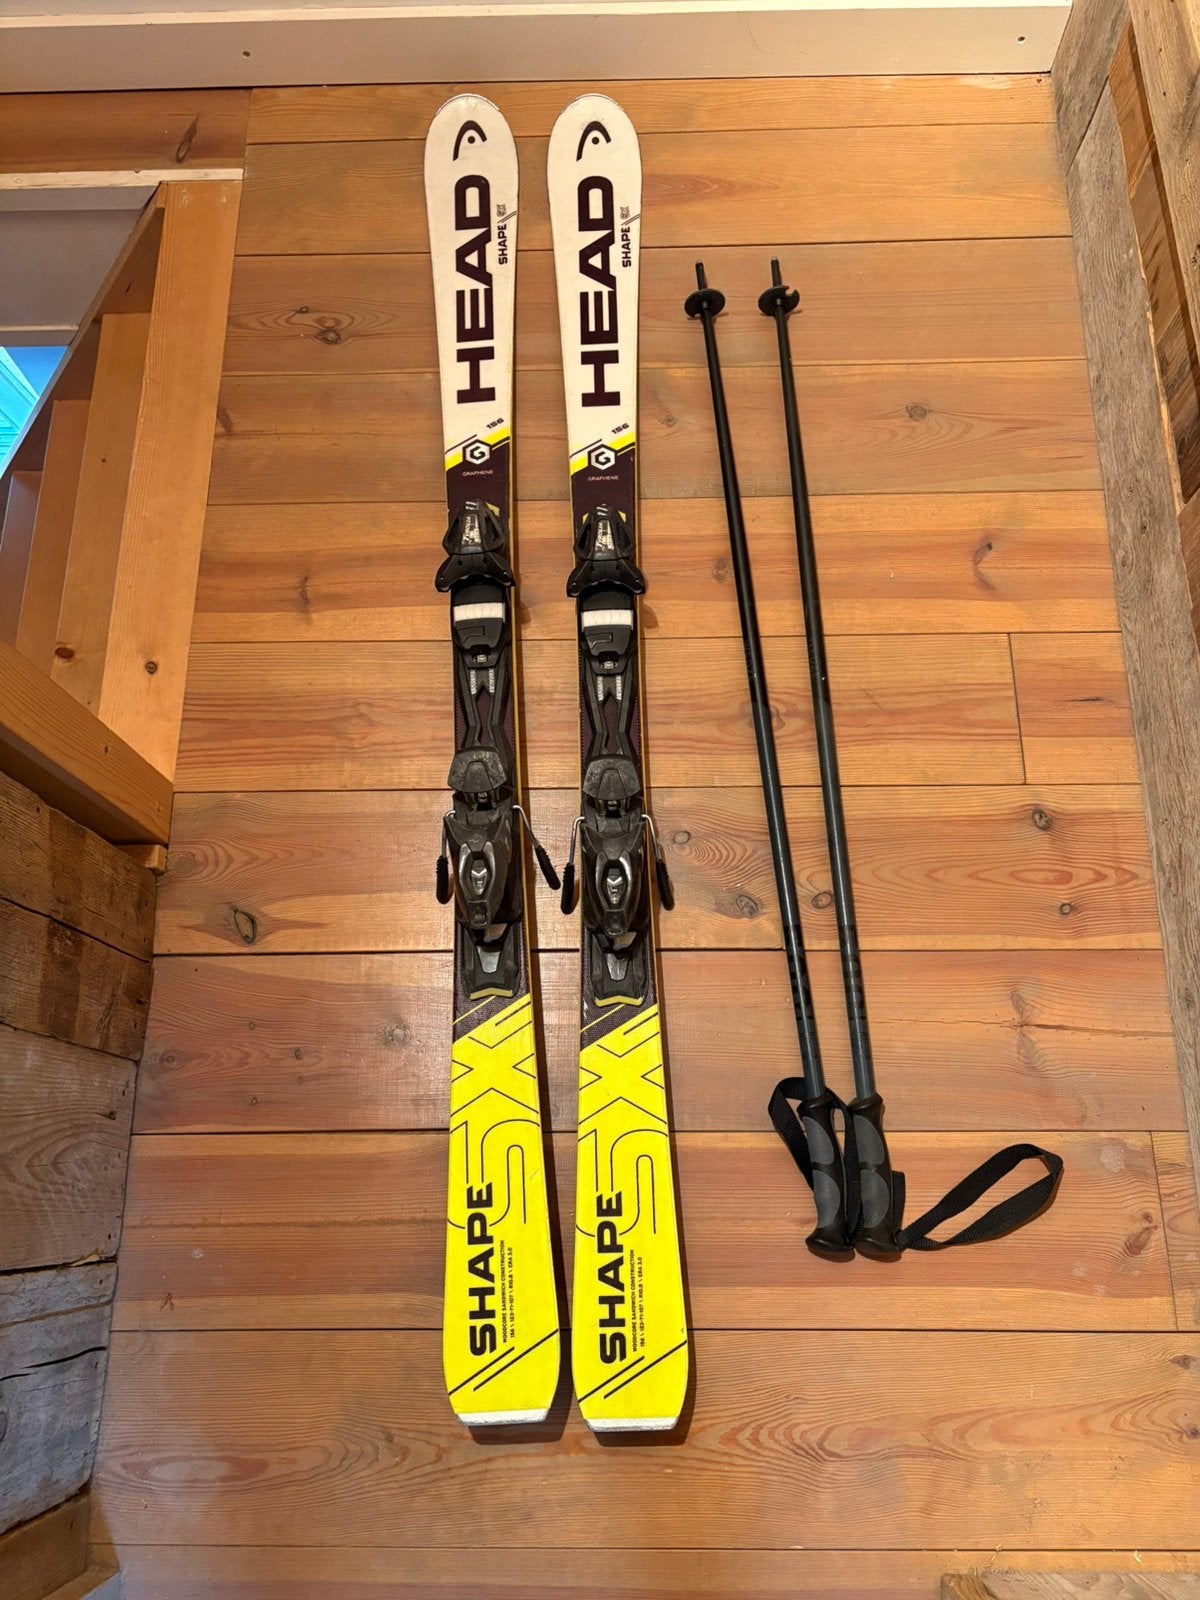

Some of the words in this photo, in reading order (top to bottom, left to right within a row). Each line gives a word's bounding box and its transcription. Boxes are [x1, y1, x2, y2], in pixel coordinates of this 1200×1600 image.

[497, 224, 508, 265] SHAPE
[620, 227, 631, 268] SHAPE
[454, 174, 496, 404] HEAD
[577, 175, 621, 407] HEAD
[486, 417, 504, 429] 156
[611, 422, 629, 434] 156
[462, 469, 493, 477] GRAPHENE
[470, 445, 486, 461] G
[594, 451, 611, 466] G
[466, 1182, 497, 1356] SHAPE
[596, 1191, 627, 1364] SHAPE
